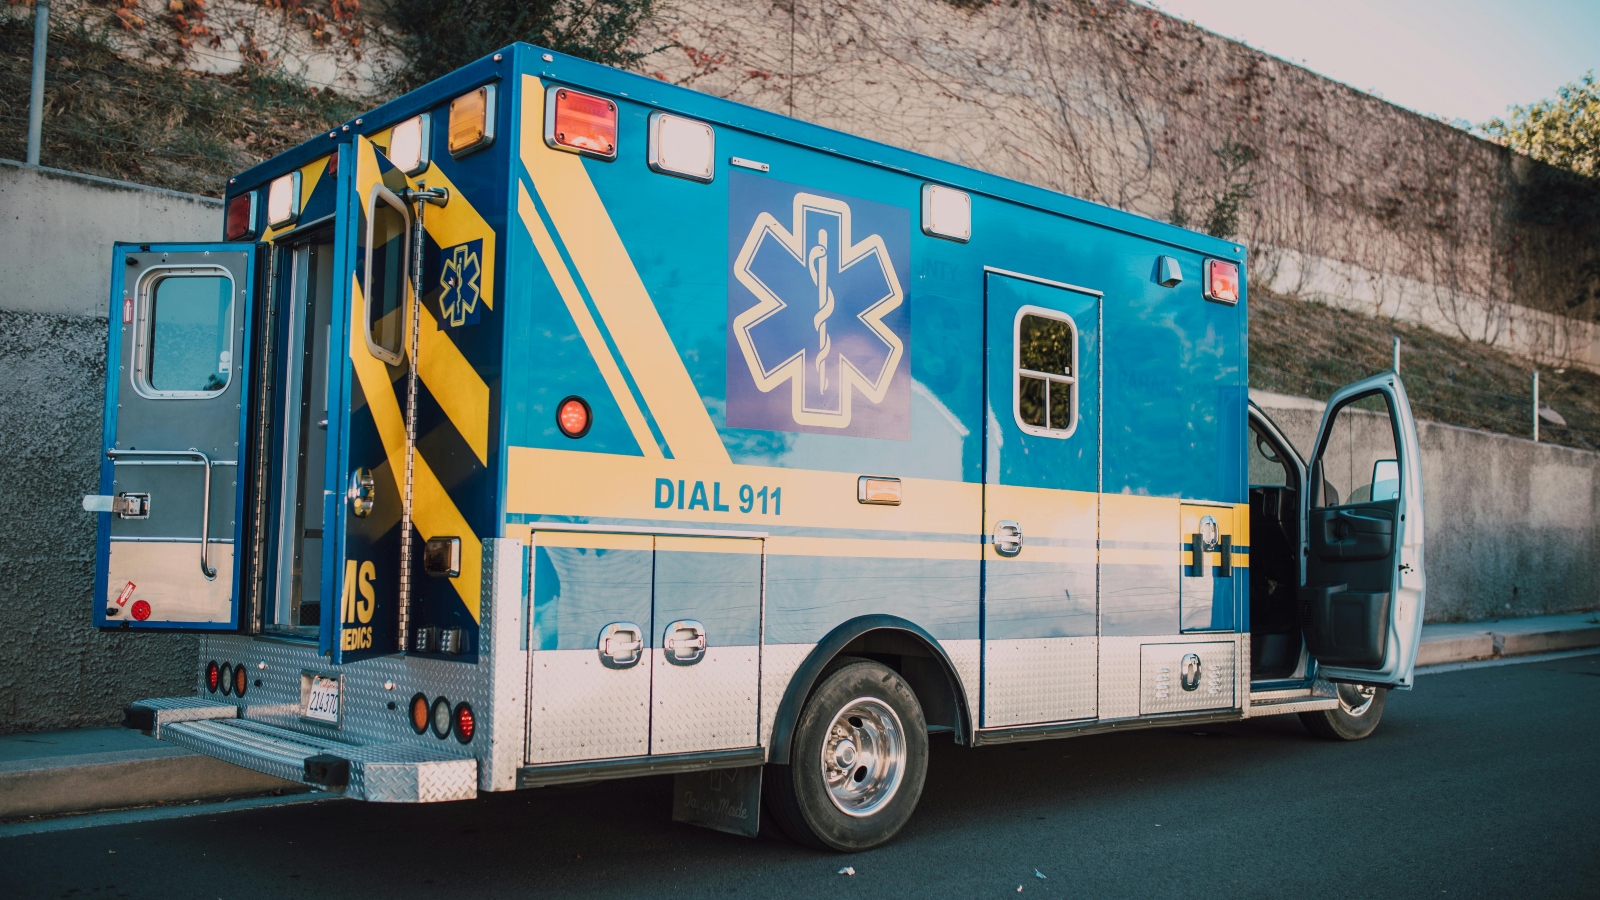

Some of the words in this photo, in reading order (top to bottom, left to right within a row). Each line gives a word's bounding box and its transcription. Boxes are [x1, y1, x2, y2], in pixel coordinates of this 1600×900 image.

[654, 477, 730, 513] DIAL
[738, 483, 782, 516] 911
[717, 797, 748, 819] Made
